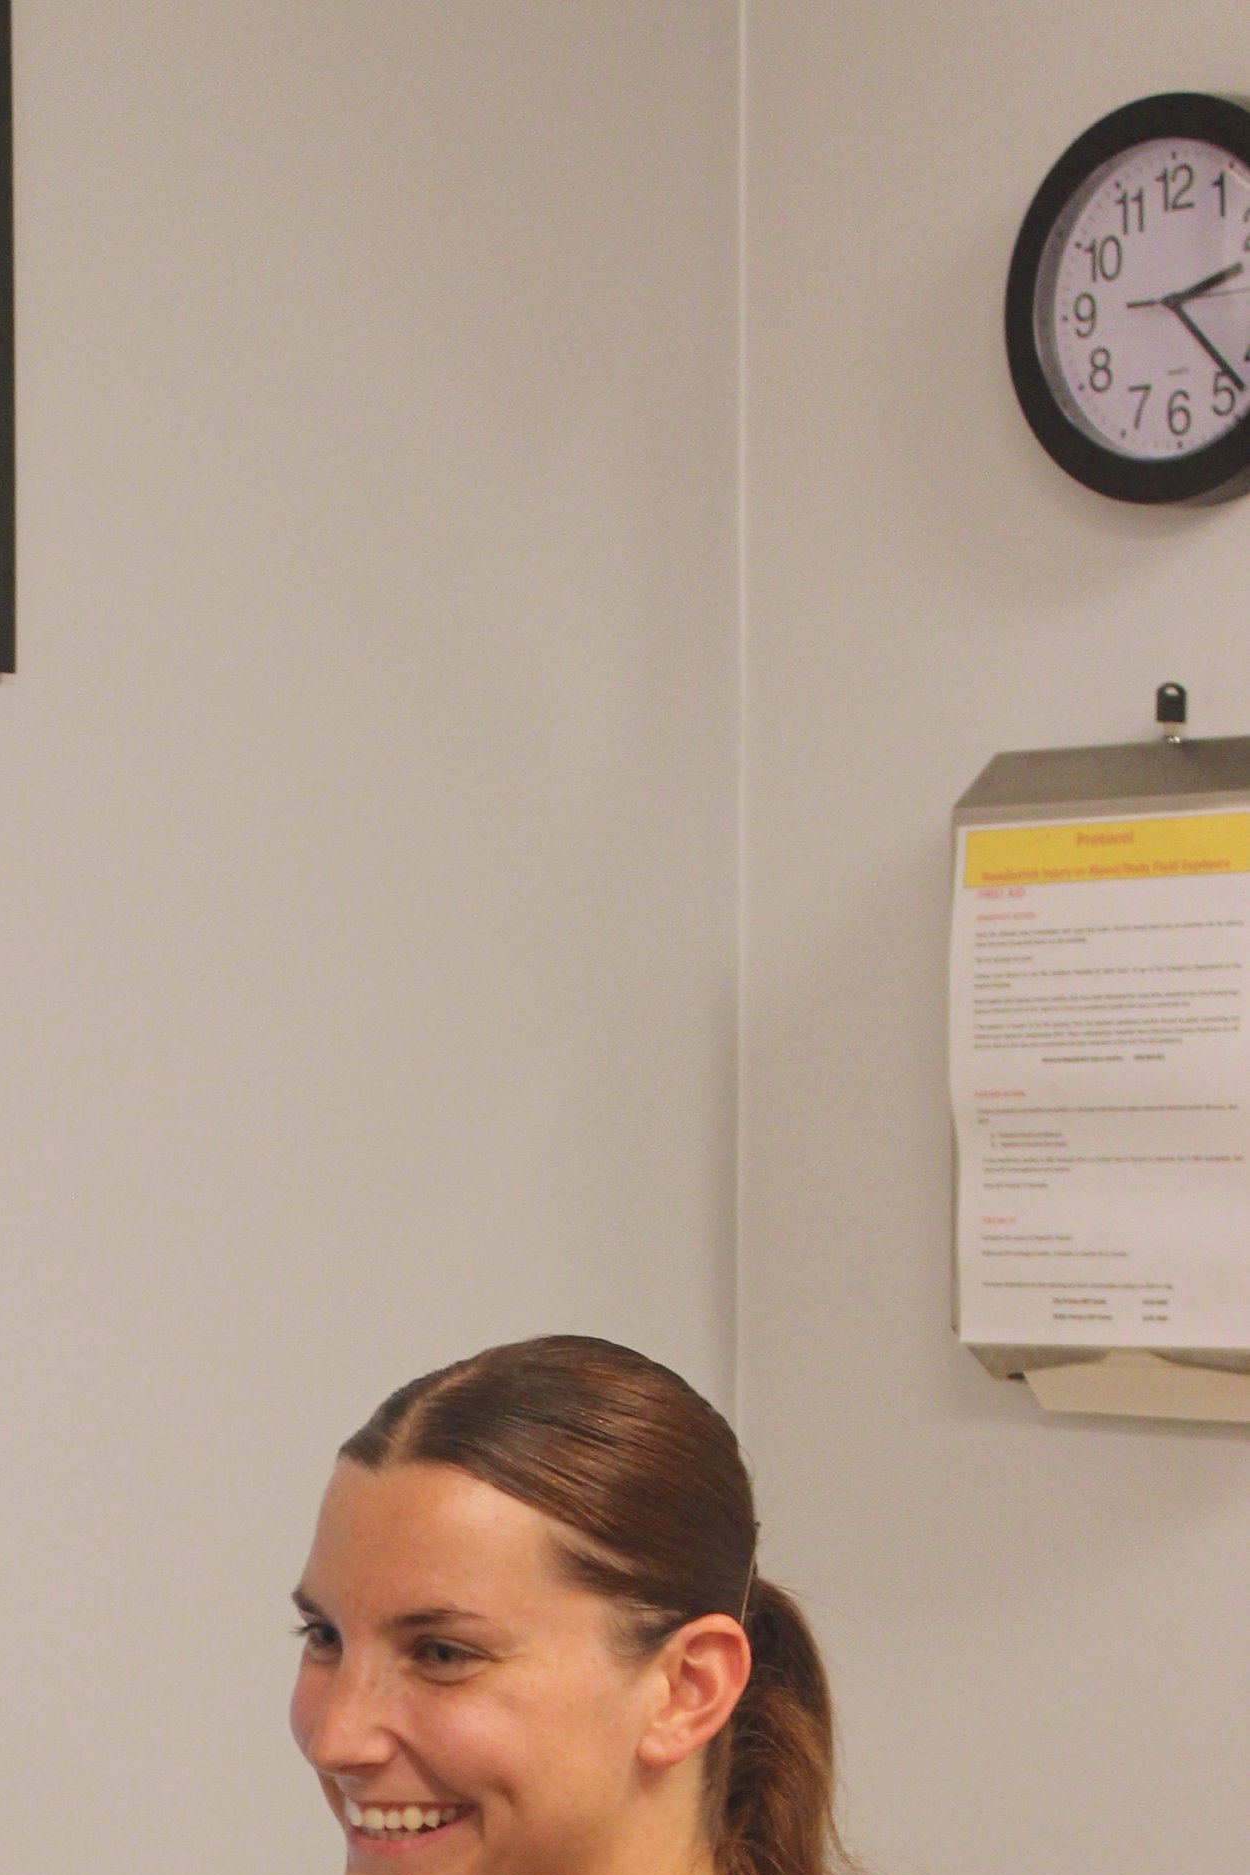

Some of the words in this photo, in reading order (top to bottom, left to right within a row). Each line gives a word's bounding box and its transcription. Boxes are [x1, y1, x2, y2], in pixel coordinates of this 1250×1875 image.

[1156, 163, 1194, 212] 12
[1211, 171, 1226, 217] 1
[1116, 187, 1145, 235] 11
[1084, 235, 1122, 282] 10
[1074, 293, 1097, 338] 9
[1089, 347, 1113, 393] 8
[1212, 370, 1235, 416] 5
[1128, 384, 1151, 429] 7
[1167, 389, 1191, 436] 6
